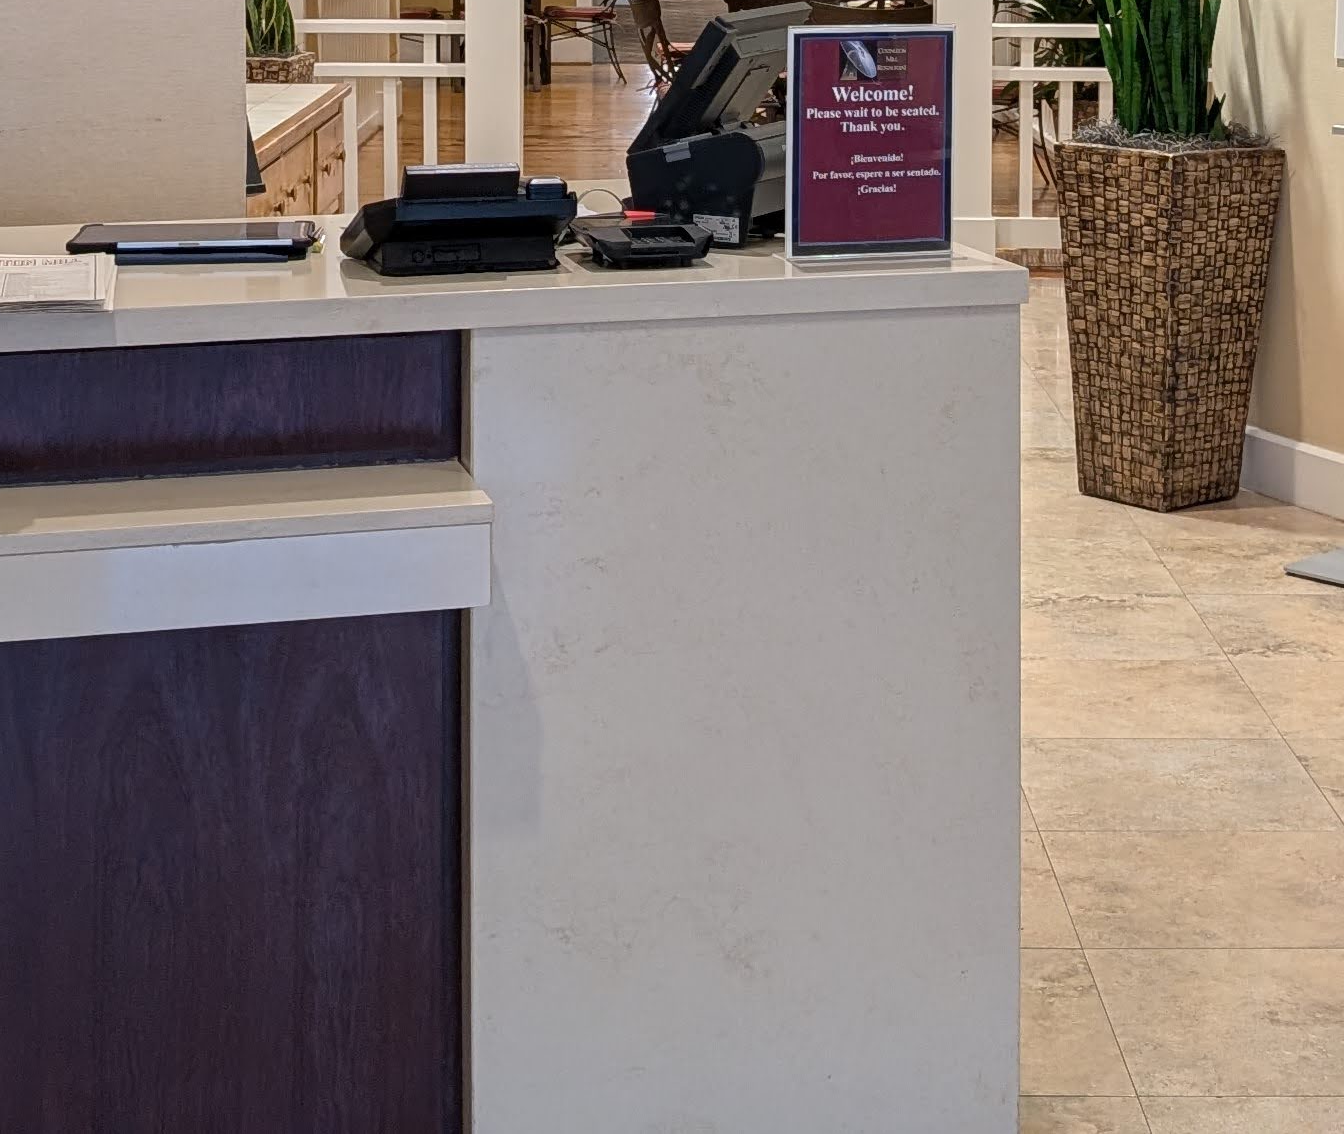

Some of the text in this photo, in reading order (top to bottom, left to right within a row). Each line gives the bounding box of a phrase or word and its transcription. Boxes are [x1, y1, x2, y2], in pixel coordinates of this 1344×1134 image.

[832, 85, 914, 102] Welcome!
[806, 106, 939, 119] Please wait to be seated.
[840, 121, 905, 134] Thank you.
[812, 171, 827, 180] Por
[830, 170, 854, 180] favor,
[856, 171, 883, 181] espere
